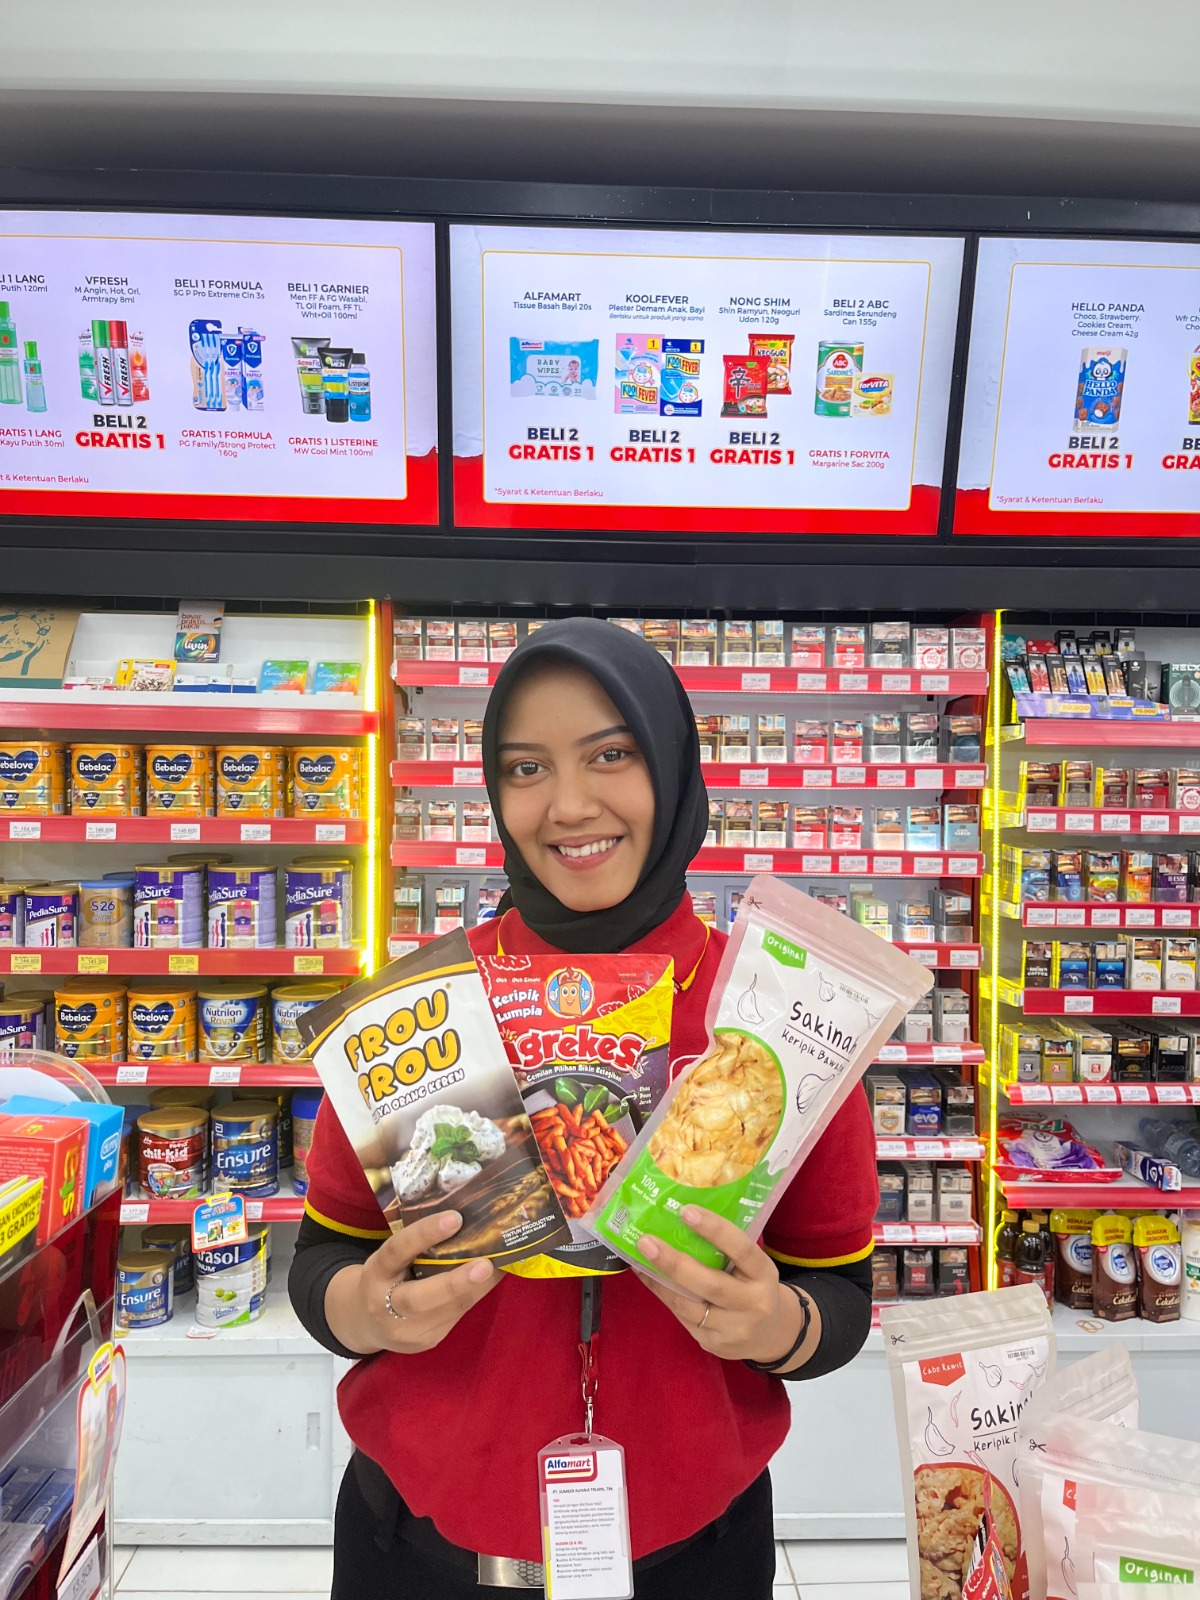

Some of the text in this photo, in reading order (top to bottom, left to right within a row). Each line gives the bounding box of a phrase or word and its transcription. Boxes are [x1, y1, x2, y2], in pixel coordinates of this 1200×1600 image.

[16, 274, 45, 283] LANG
[85, 276, 128, 286] VFRESH
[174, 279, 263, 290] BELI FORMULA
[287, 283, 369, 294] BELI GARNIER
[82, 295, 118, 304] Armtrapy
[524, 292, 582, 302] ALFAMART
[626, 294, 689, 305] KOOLFEVER
[730, 297, 790, 307] NONG SHIM
[538, 302, 560, 310] Basah
[562, 303, 578, 311] Bayi
[636, 305, 666, 313] Demam
[689, 306, 705, 315] Bayi
[833, 300, 889, 309] BELI ABC
[1072, 303, 1145, 313] HELLO PANDA
[334, 312, 358, 320] 100ml
[771, 308, 800, 316] Neoguri
[856, 310, 897, 318] Serundeng
[762, 317, 779, 325] 120g
[1072, 329, 1098, 337] Cheese
[1125, 330, 1138, 338] 42g
[1086, 380, 1116, 389] HELLO
[1083, 387, 1117, 396] PANDA
[94, 414, 147, 428] BELI 2
[35, 430, 62, 438] LANG
[182, 430, 272, 440] GRATIS FORMULA
[527, 428, 579, 441] BELI 2
[629, 430, 680, 443] BELI 2
[729, 432, 780, 445] BELI 2
[0, 439, 20, 448] Kayu
[44, 440, 65, 448] 30ml
[75, 432, 165, 449] GRATIS 1
[247, 442, 276, 450] Protect
[288, 437, 379, 447] GRATIS LISTERINE
[1068, 437, 1119, 449] BELI 2
[218, 450, 238, 459] 160g
[349, 448, 374, 457] 100ml
[508, 445, 594, 460] GRATIS 1
[610, 447, 695, 463] GRATIS 1
[710, 449, 794, 465] GRATIS 1
[809, 450, 890, 459] GRATIS FORVITA
[812, 460, 849, 468] Margarine
[866, 461, 885, 469] 200g
[1048, 453, 1132, 468] GRATIS 1
[13, 474, 89, 484] Ketentuan Berlaku
[531, 489, 603, 498] Ketentuan Berlaku
[1031, 496, 1072, 504] Ketentuan
[79, 762, 112, 772] Bebelac
[155, 763, 187, 772] Bebelac
[223, 763, 255, 772] Bebelac
[300, 764, 331, 773] Bebelac
[37, 785, 46, 799] 2
[118, 785, 126, 797] 3
[193, 785, 201, 798] 3
[258, 785, 268, 798] 4
[336, 785, 345, 798] 4
[29, 906, 68, 919] PediaSure
[767, 936, 804, 962] Original
[492, 989, 540, 1009] Keripik
[60, 1012, 91, 1022] Bebelac
[132, 1011, 169, 1022] Bebelove
[206, 1007, 242, 1017] Nutrilon
[495, 1005, 543, 1024] Lumpia
[344, 989, 449, 1072] FROU
[781, 1028, 816, 1056] Keripik
[358, 1028, 461, 1110] FROU
[527, 1064, 622, 1082] Cemilan Pilihan Bikin Ketagihan
[391, 1068, 465, 1111] ORANG KEREN
[217, 1144, 271, 1168] Ensure
[7, 1210, 35, 1240] GRATIS
[522, 1214, 556, 1231] PRODUCTION
[121, 1288, 161, 1306] Ensure
[974, 1436, 1010, 1451] Keripik
[547, 1458, 591, 1469] Alfamart
[1125, 1562, 1189, 1585] Original
